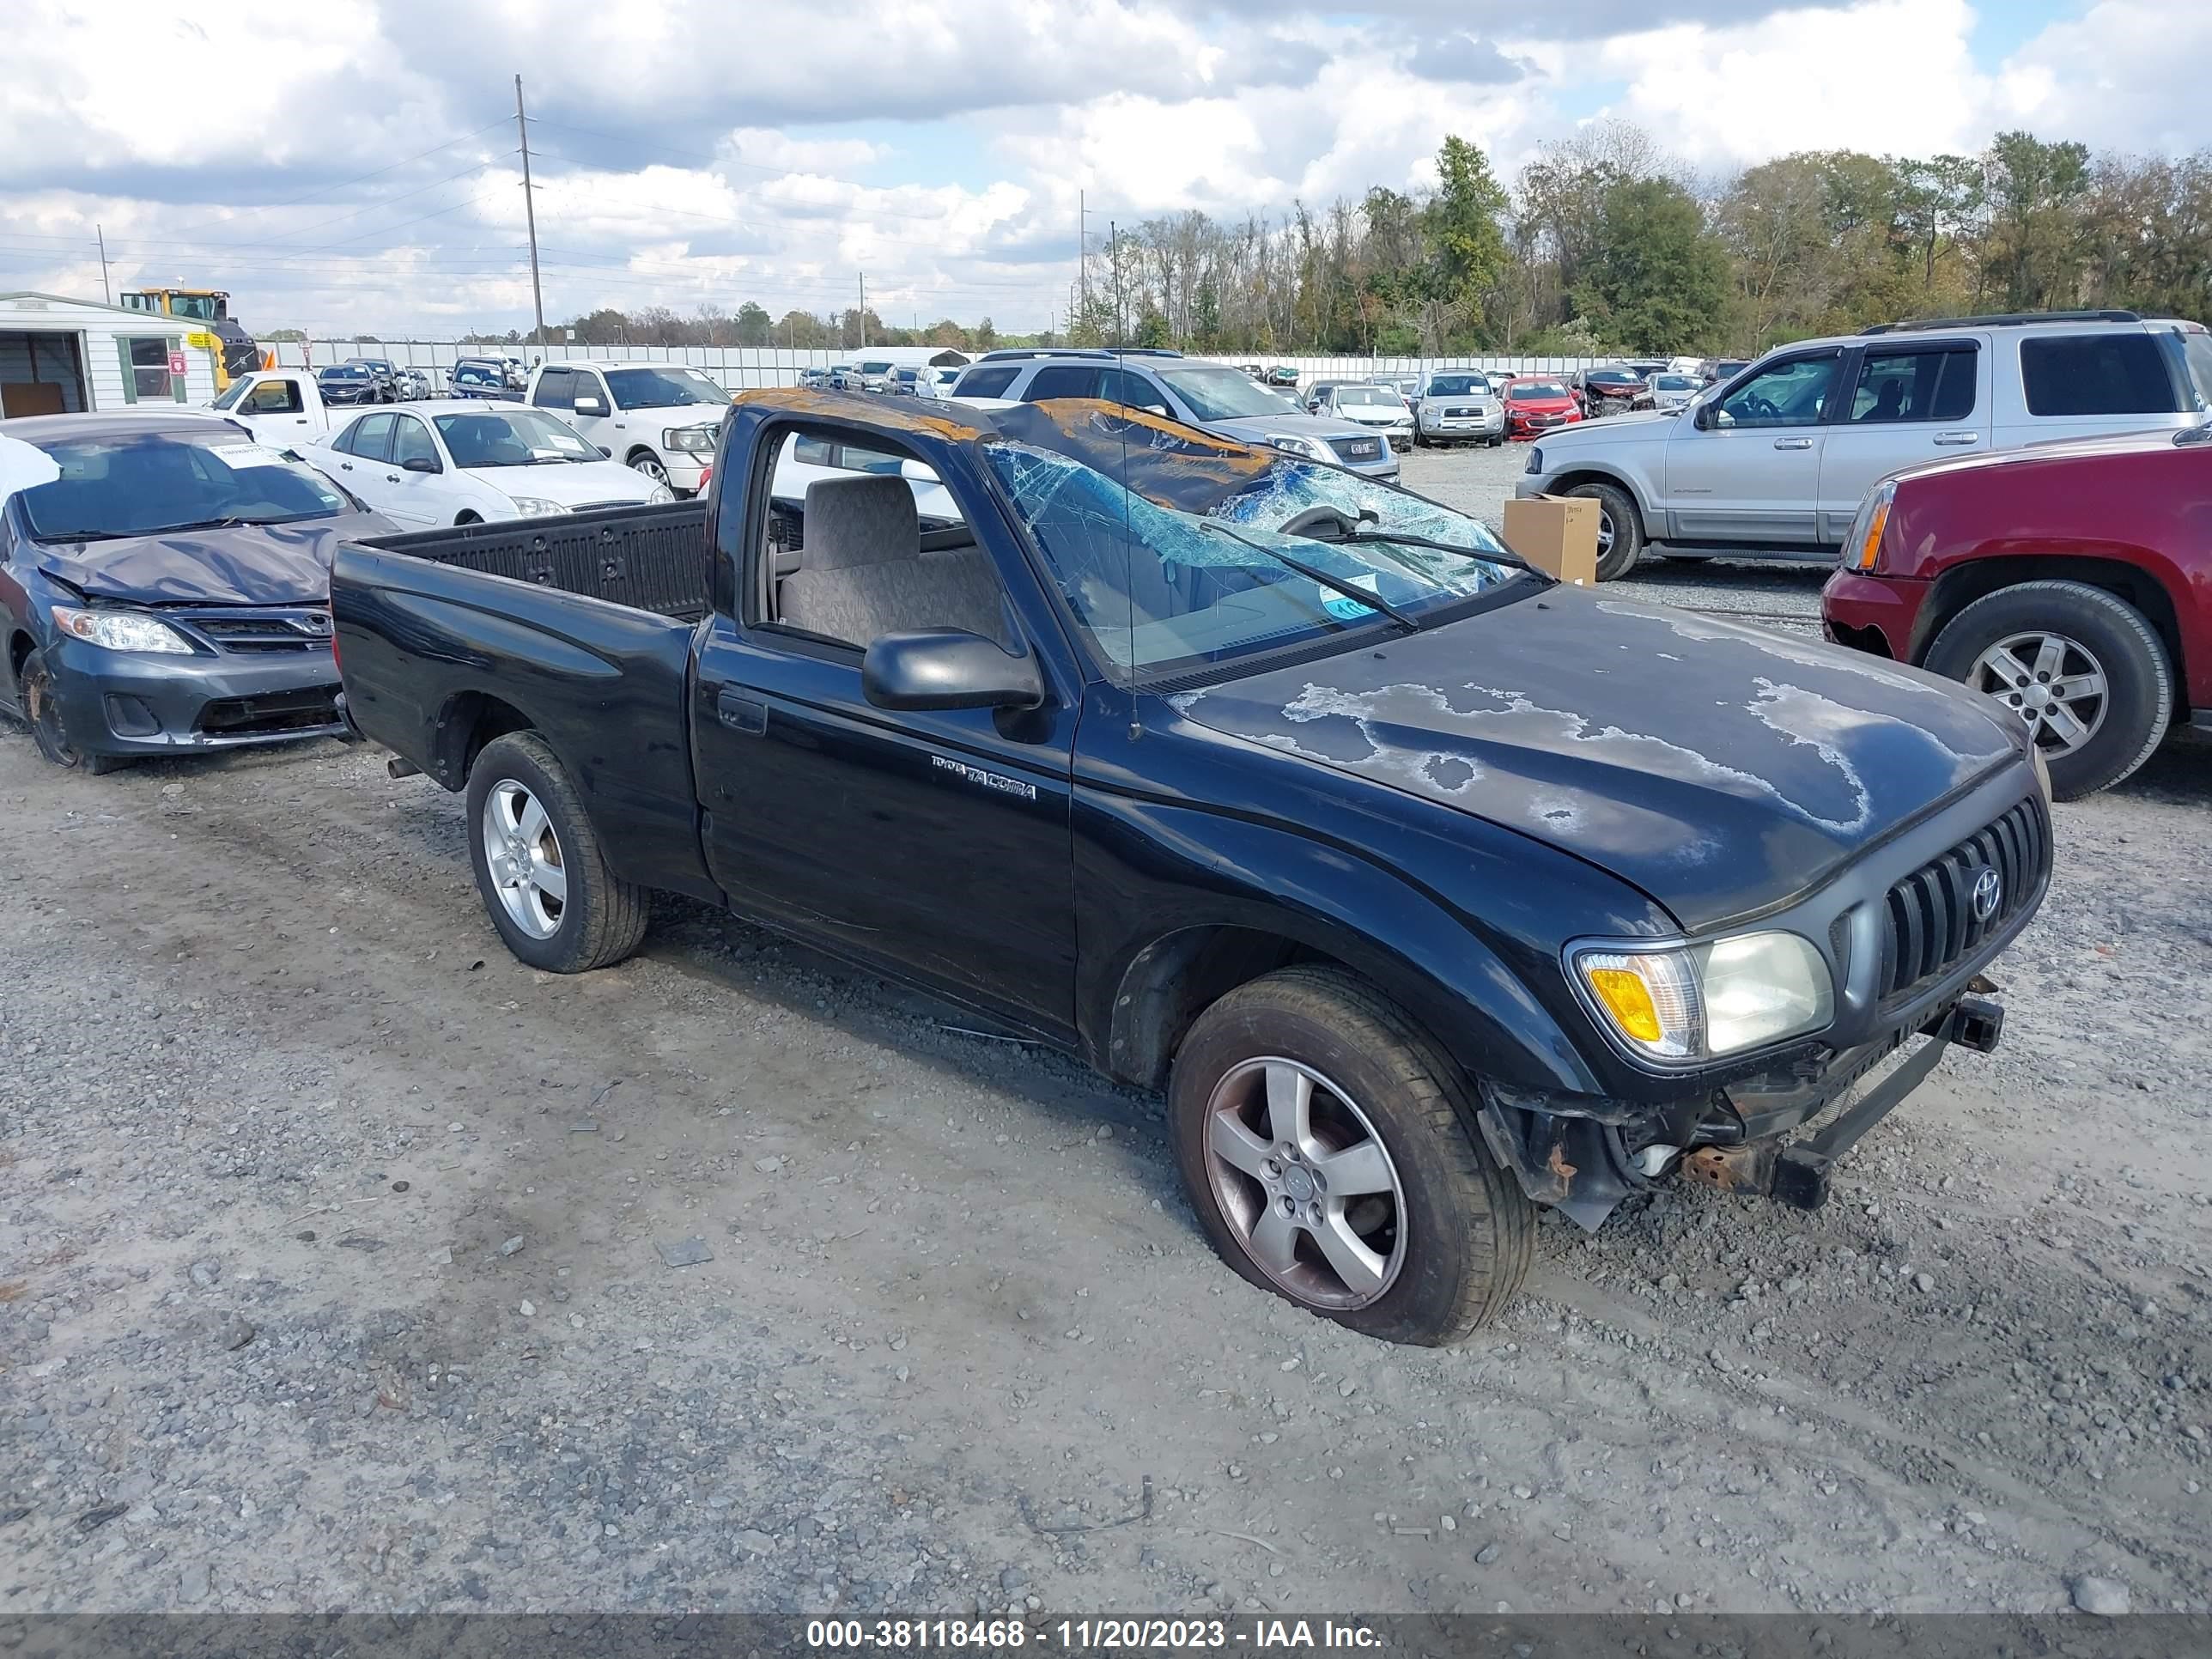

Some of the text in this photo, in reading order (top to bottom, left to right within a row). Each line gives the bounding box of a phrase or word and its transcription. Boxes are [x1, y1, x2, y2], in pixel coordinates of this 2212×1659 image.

[1351, 442, 1375, 454] GMC
[931, 756, 1036, 799] TOYOTA TACOMA
